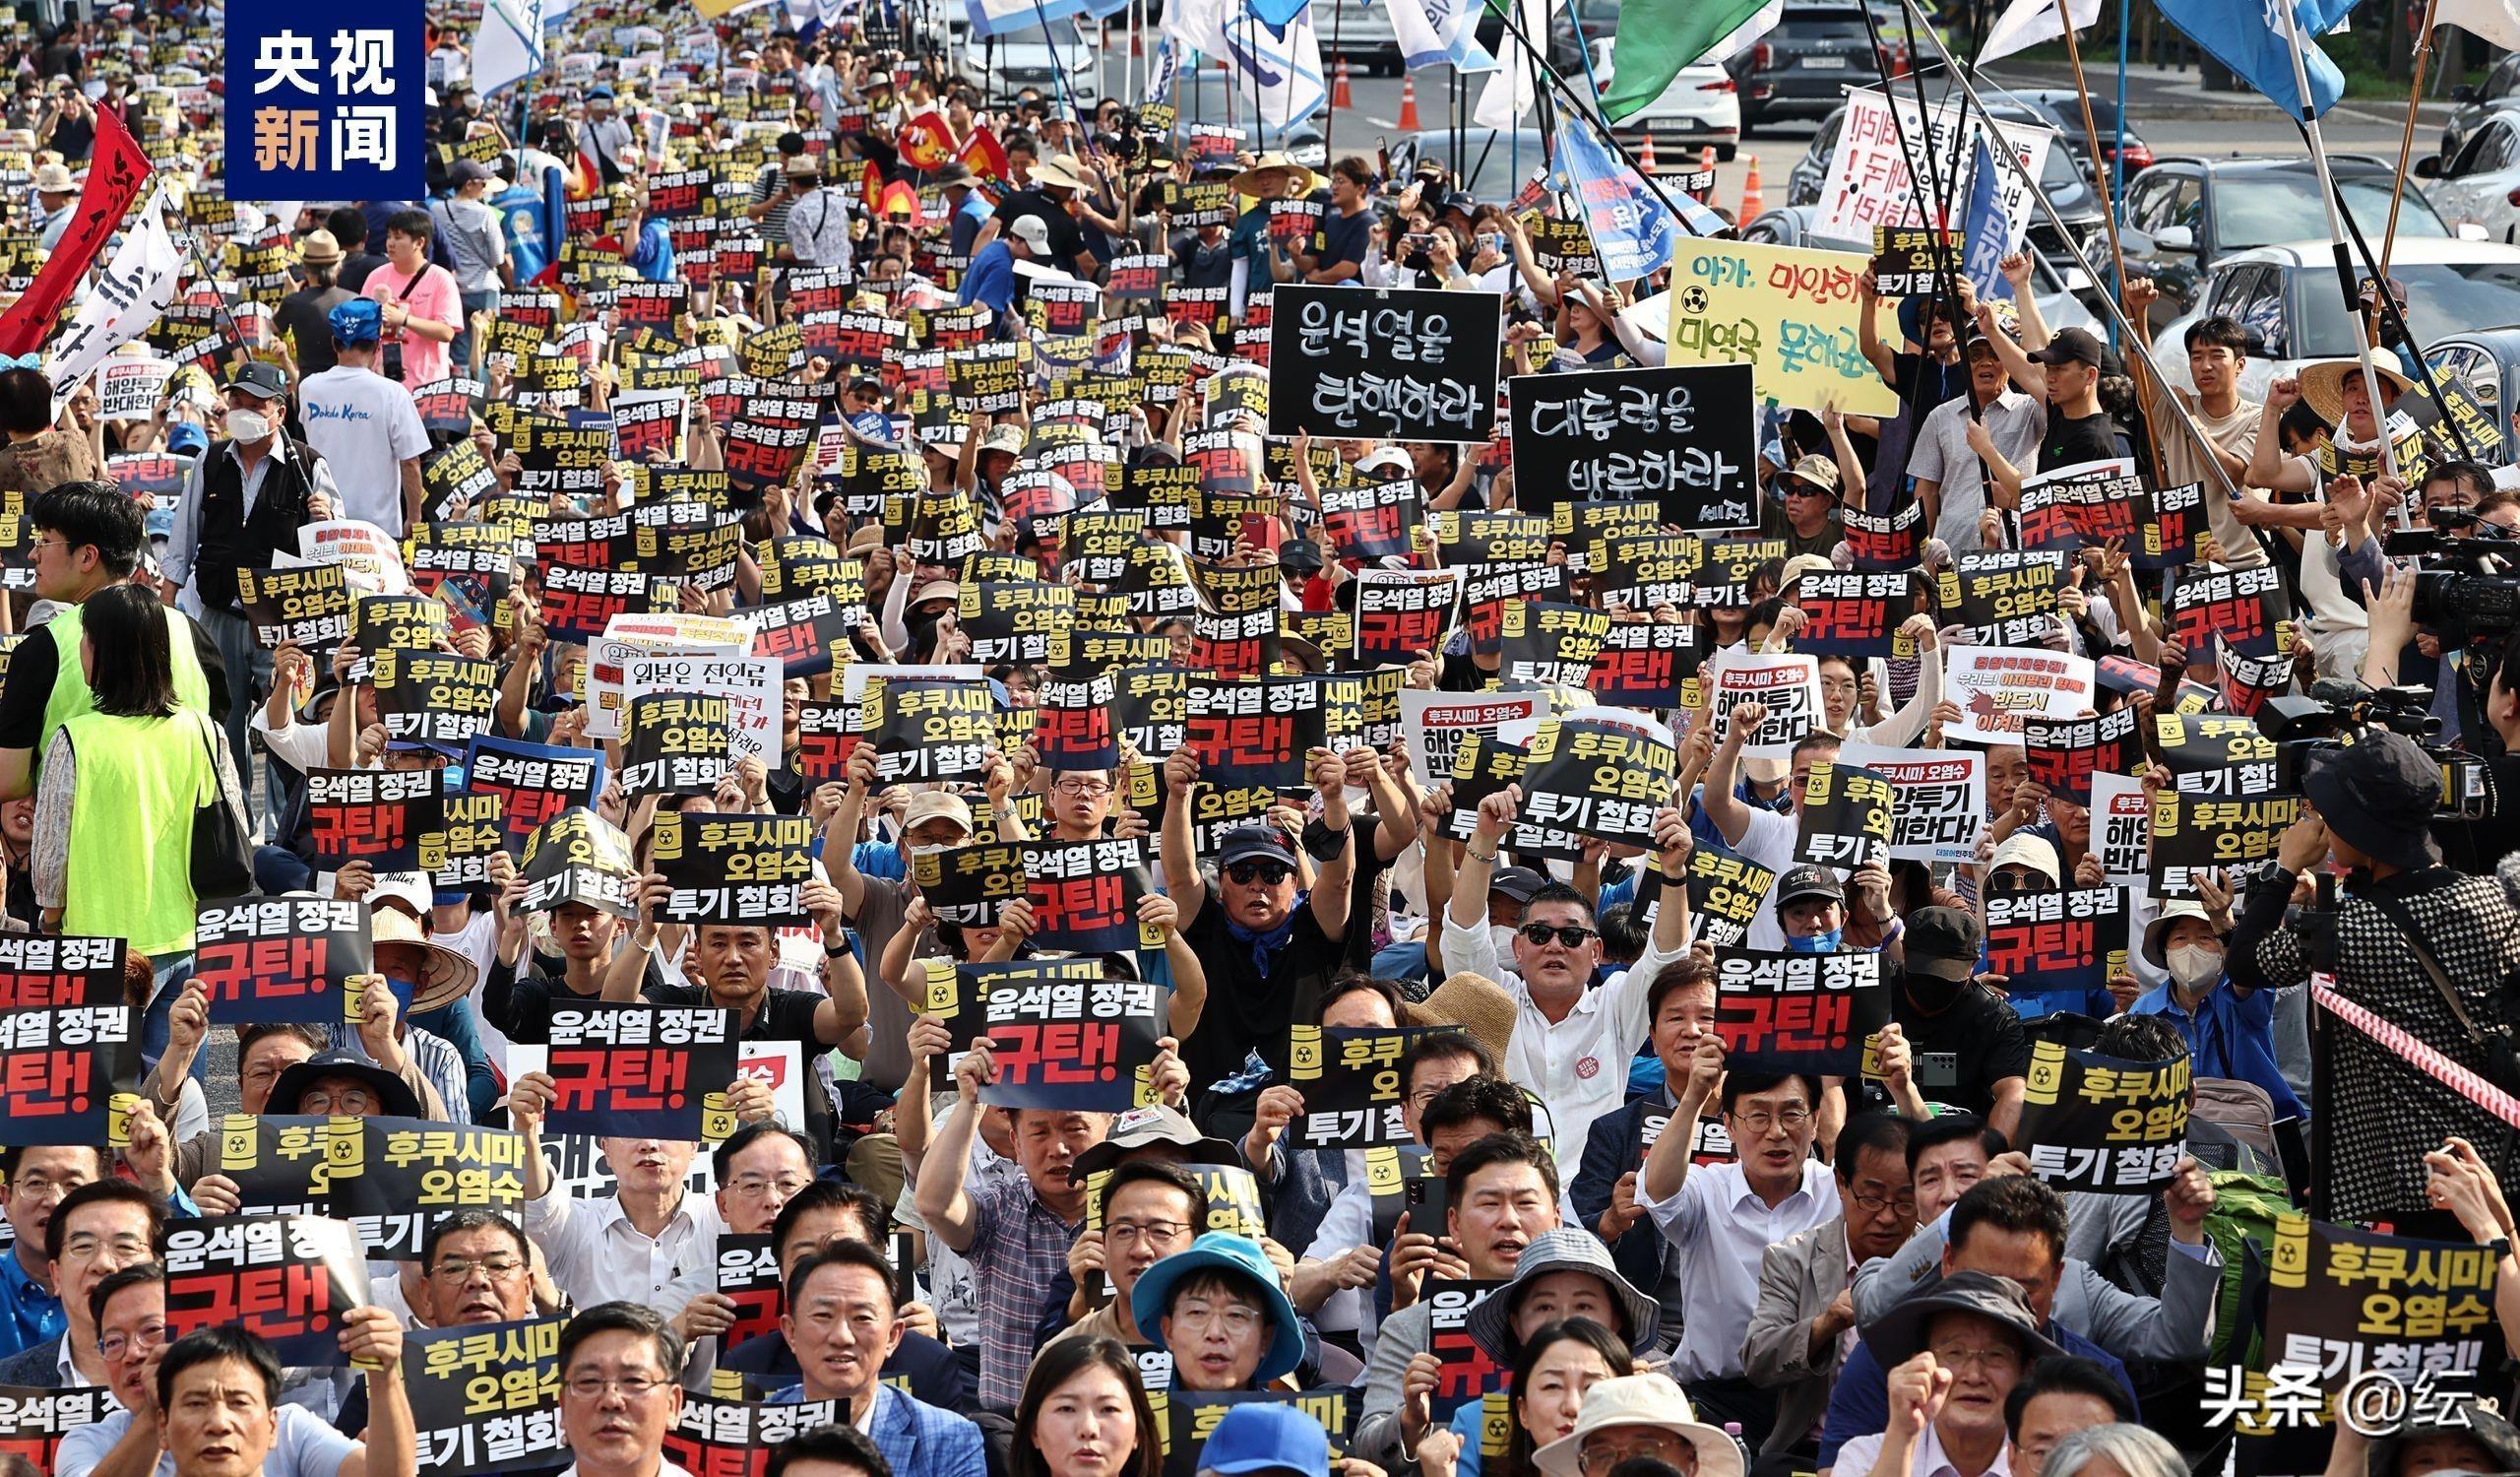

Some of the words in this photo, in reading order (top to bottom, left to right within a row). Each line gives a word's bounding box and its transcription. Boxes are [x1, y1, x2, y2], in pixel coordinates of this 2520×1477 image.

[649, 173, 686, 190] 윤석열
[685, 169, 710, 185] 정권
[1689, 170, 1714, 190] 정권
[715, 253, 754, 273] 규탄!
[1539, 251, 1564, 271] 투기
[1110, 270, 1157, 290] 규탄!
[1768, 263, 1896, 309] 미안하.
[618, 297, 669, 322] 규탄!
[1166, 302, 1215, 323] 규탄!
[498, 321, 541, 341] 후쿠시마
[502, 337, 538, 353] 오염수
[1298, 299, 1453, 364] 윤석열을
[1676, 317, 1762, 365] 미역국
[306, 401, 339, 422] Dokdo
[341, 402, 374, 420] Korea
[1312, 370, 1484, 434] 탄핵하라
[1530, 384, 1695, 443] 대통령을
[616, 417, 673, 453] 규탄!
[109, 457, 177, 482] 규탄!
[520, 470, 559, 489] 투기
[561, 468, 605, 487] 철회!
[1132, 466, 1201, 488] 후쿠시마
[486, 497, 549, 520] 후쿠시마
[1210, 496, 1279, 517] 후쿠시마
[2163, 482, 2199, 512] 정권
[1072, 512, 1144, 537] 후쿠시마
[1325, 511, 1399, 546] 규탄!
[1584, 502, 1661, 528] 후쿠시마
[1843, 509, 1891, 533] 윤석열
[1893, 501, 1921, 533] 정권
[667, 521, 738, 554] 후쿠시마
[1487, 540, 1548, 560] 오염수
[1616, 539, 1692, 565] 후쿠시마
[1846, 529, 1912, 560] 규탄!
[685, 542, 737, 572] 오염수
[263, 564, 344, 599] 후쿠시마
[1798, 573, 1863, 598] 윤석열
[1865, 572, 1908, 597] 정권
[1972, 565, 2056, 600] 후쿠시마
[2174, 578, 2235, 610] 윤석열
[2236, 565, 2279, 593] 정권
[283, 590, 347, 621] 오염수
[541, 593, 628, 631] 규탄!
[1798, 600, 1883, 639] 규탄!
[1358, 610, 1441, 651] 규탄!
[2176, 598, 2262, 650] 규탄!
[408, 657, 496, 690] 후쿠시마
[633, 662, 691, 685] 일본은
[702, 663, 767, 687] 전인류
[1188, 640, 1260, 676] 규탄!
[1589, 651, 1672, 691] 규탄!
[1975, 656, 2068, 674] 검찰독재정권!
[1041, 680, 1084, 708] 윤석열
[1087, 674, 1114, 701] 정권
[1187, 687, 1263, 715] 윤석열
[1268, 680, 1317, 713] 정권
[1957, 673, 1998, 686] 우리는!
[2000, 674, 2052, 687] 이재명과
[2055, 677, 2086, 693] 함께!
[639, 699, 728, 729] 후쿠시마
[896, 688, 993, 718] 후쿠시마
[1427, 709, 1481, 725] 후쿠시마
[1482, 705, 1524, 722] 오염수
[1992, 691, 2048, 711] 반드시
[922, 716, 994, 741] 오염수
[1035, 709, 1109, 750] 규탄!
[1186, 717, 1293, 766] 규탄!
[2025, 722, 2096, 748] 윤석열
[2100, 708, 2135, 739] 정권
[472, 754, 548, 781] 윤석열
[550, 761, 591, 791] 정권
[1569, 732, 1676, 778] 후쿠시마
[2028, 744, 2119, 792] 규탄!
[308, 776, 372, 803] 윤석열
[377, 770, 432, 799] 정권
[1589, 764, 1673, 803] 오염수
[1198, 786, 1276, 819] 오염수
[1526, 791, 1589, 828] 투기
[2191, 800, 2301, 830] 후쿠시마
[310, 804, 406, 855] 규탄!
[698, 818, 811, 852] 후쿠시마
[724, 855, 811, 880] 오염수
[1022, 846, 1091, 877] 윤석열
[1095, 838, 1141, 872] 정권
[1806, 835, 1863, 866] 투기
[1935, 848, 1975, 860] 더불어민주당
[379, 870, 416, 886] Millet
[1689, 849, 1775, 898] 후쿠시마
[198, 906, 291, 935] 윤석열
[296, 901, 360, 931] 정권
[666, 887, 731, 921] 투기
[1032, 876, 1125, 931] 규탄!
[1707, 887, 1758, 925] 오염수
[1985, 888, 2065, 926] 윤석열
[2069, 886, 2120, 917] 정권
[0, 939, 52, 971] 석열
[59, 938, 115, 970] 정권
[1986, 922, 2095, 976] 규탄!
[199, 938, 328, 997] 규탄!
[1717, 955, 1818, 993] 윤석열
[1823, 953, 1881, 987] 정권
[987, 985, 1083, 1020] 윤석열
[1091, 984, 1157, 1018] 정권
[550, 1007, 653, 1047] 윤석열
[659, 1006, 726, 1044] 정권
[1713, 997, 1851, 1057] 규탄!
[992, 1021, 1118, 1083] 규탄!
[551, 1048, 685, 1116] 규탄!
[2078, 1052, 2192, 1106] 후쿠시마
[1303, 1106, 1375, 1145] 투기
[2104, 1103, 2190, 1143] 오염수
[384, 1131, 526, 1168] 후쿠시마
[2029, 1143, 2110, 1186] 투기
[417, 1170, 525, 1206] 오염수
[165, 1223, 281, 1271] 윤석열
[2324, 1239, 2499, 1292] 후쿠시마
[165, 1264, 331, 1342] 규탄!
[2360, 1295, 2490, 1335] 오염수
[424, 1323, 560, 1380] 후쿠시마
[679, 1399, 754, 1442] 석열
[759, 1399, 836, 1444] 정권
